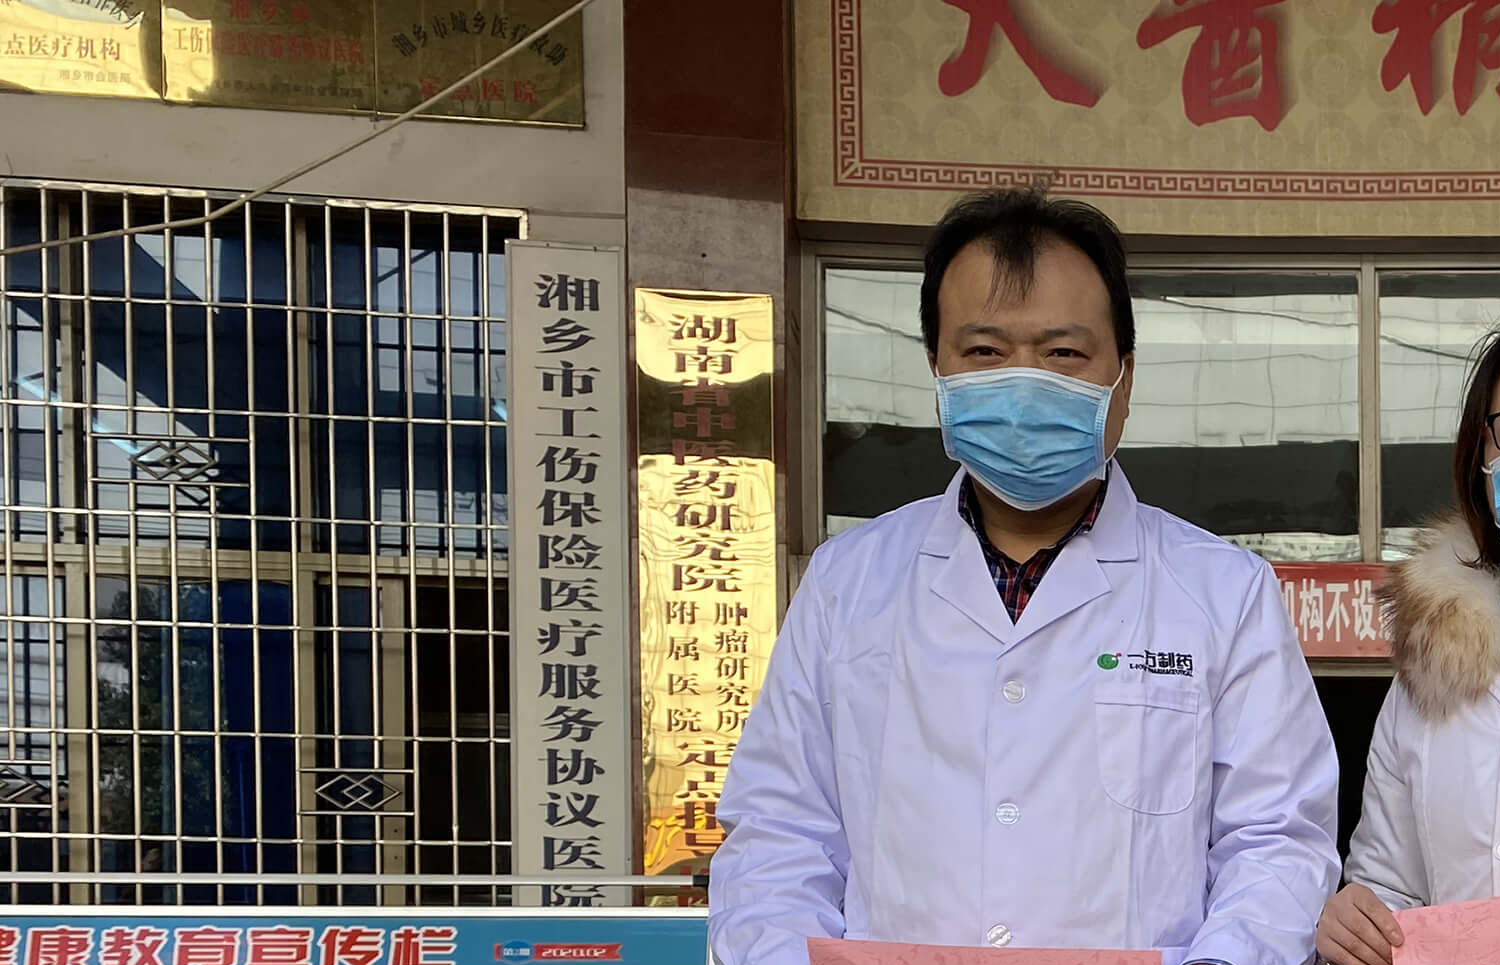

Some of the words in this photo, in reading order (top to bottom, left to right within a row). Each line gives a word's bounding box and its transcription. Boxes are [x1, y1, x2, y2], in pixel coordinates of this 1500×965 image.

[668, 313, 743, 593] 湖南省中医药研究院
[664, 600, 702, 733] 附属医院
[713, 600, 752, 734] 肿瘤研究所
